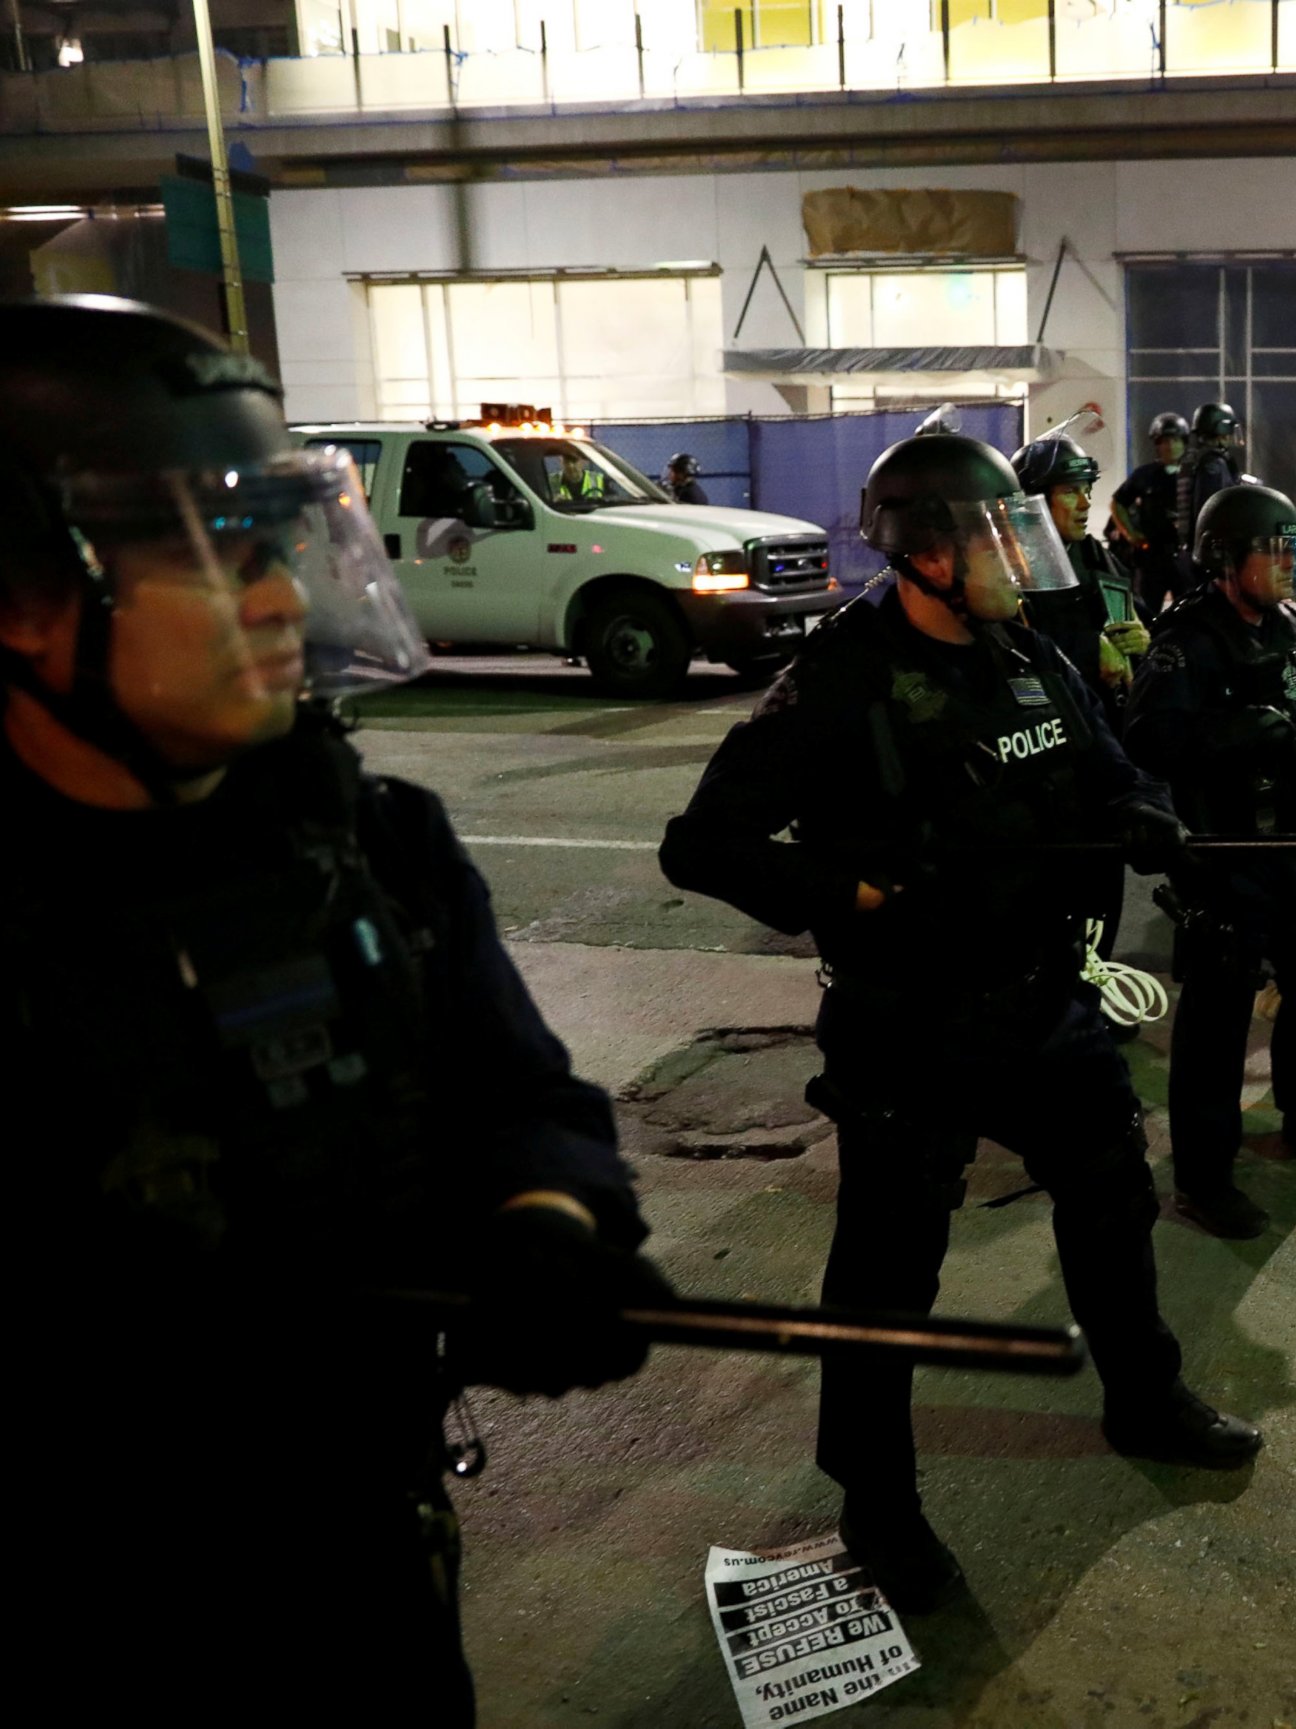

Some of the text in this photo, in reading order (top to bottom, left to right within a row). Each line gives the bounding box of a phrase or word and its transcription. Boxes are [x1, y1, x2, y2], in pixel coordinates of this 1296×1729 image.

[444, 566, 477, 576] POLICE
[997, 718, 1067, 763] POLICE
[723, 1536, 838, 1567] www.revcom.us
[741, 1559, 834, 1597] America
[744, 1576, 849, 1622] a Fascist
[742, 1611, 887, 1675] We REFUSE
[748, 1597, 863, 1647] To Accept
[755, 1645, 902, 1701] of Humanity,
[769, 1688, 839, 1721] Name
